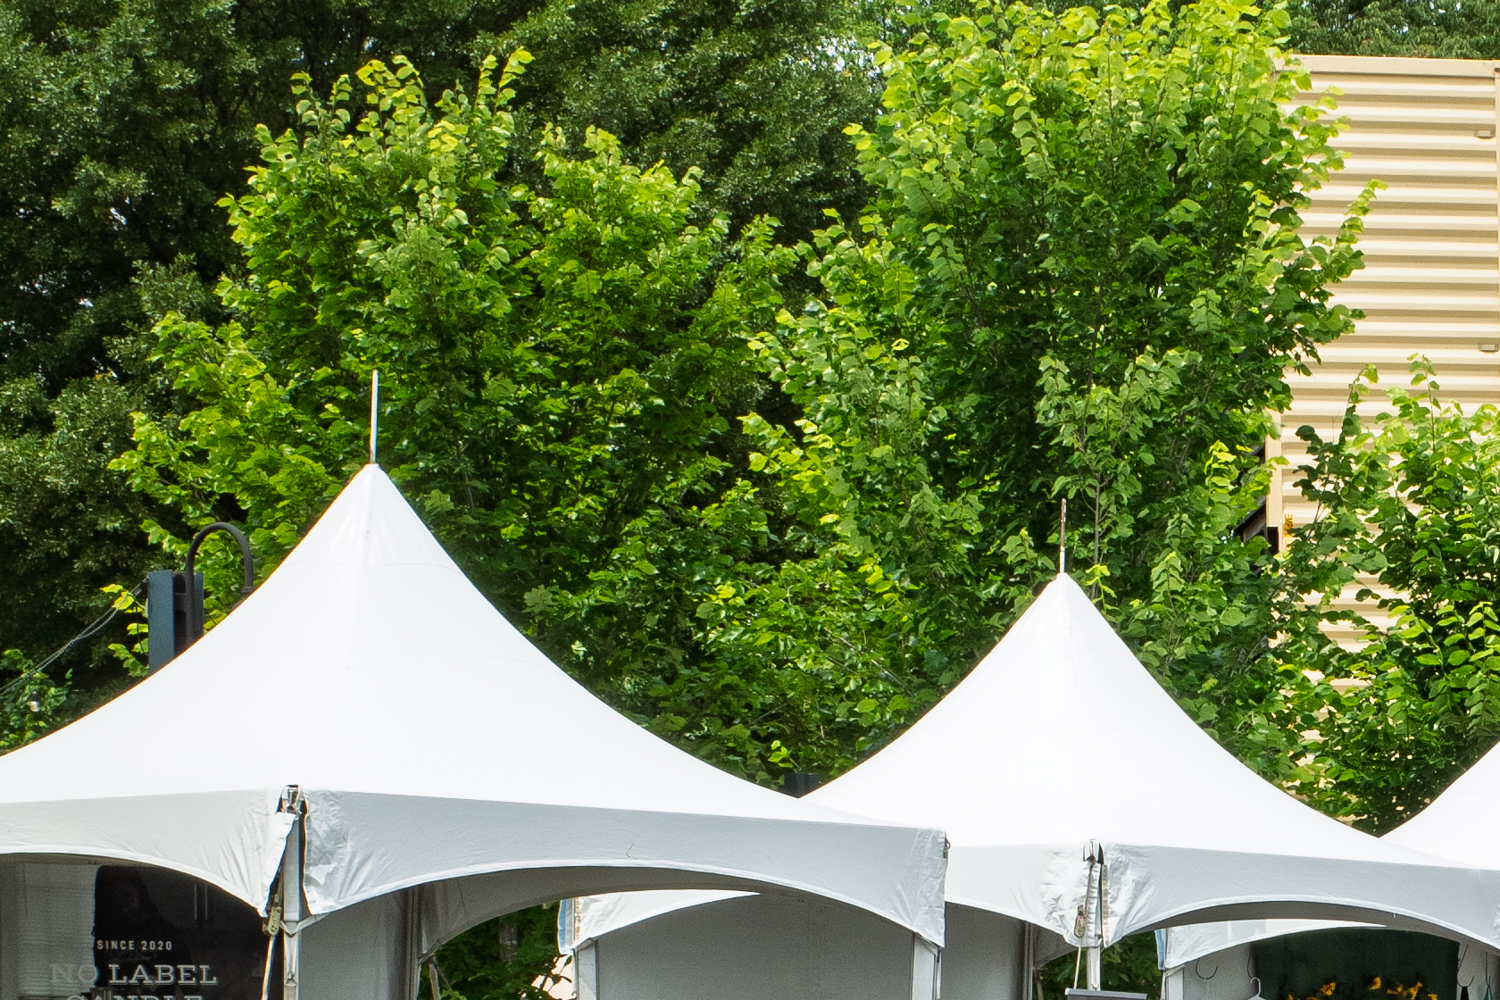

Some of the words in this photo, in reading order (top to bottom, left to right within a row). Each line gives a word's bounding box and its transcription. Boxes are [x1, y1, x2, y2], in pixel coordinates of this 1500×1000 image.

[97, 940, 135, 950] SINCE
[141, 940, 173, 950] 2020
[50, 963, 98, 985] NO
[108, 964, 218, 985] LABEL
